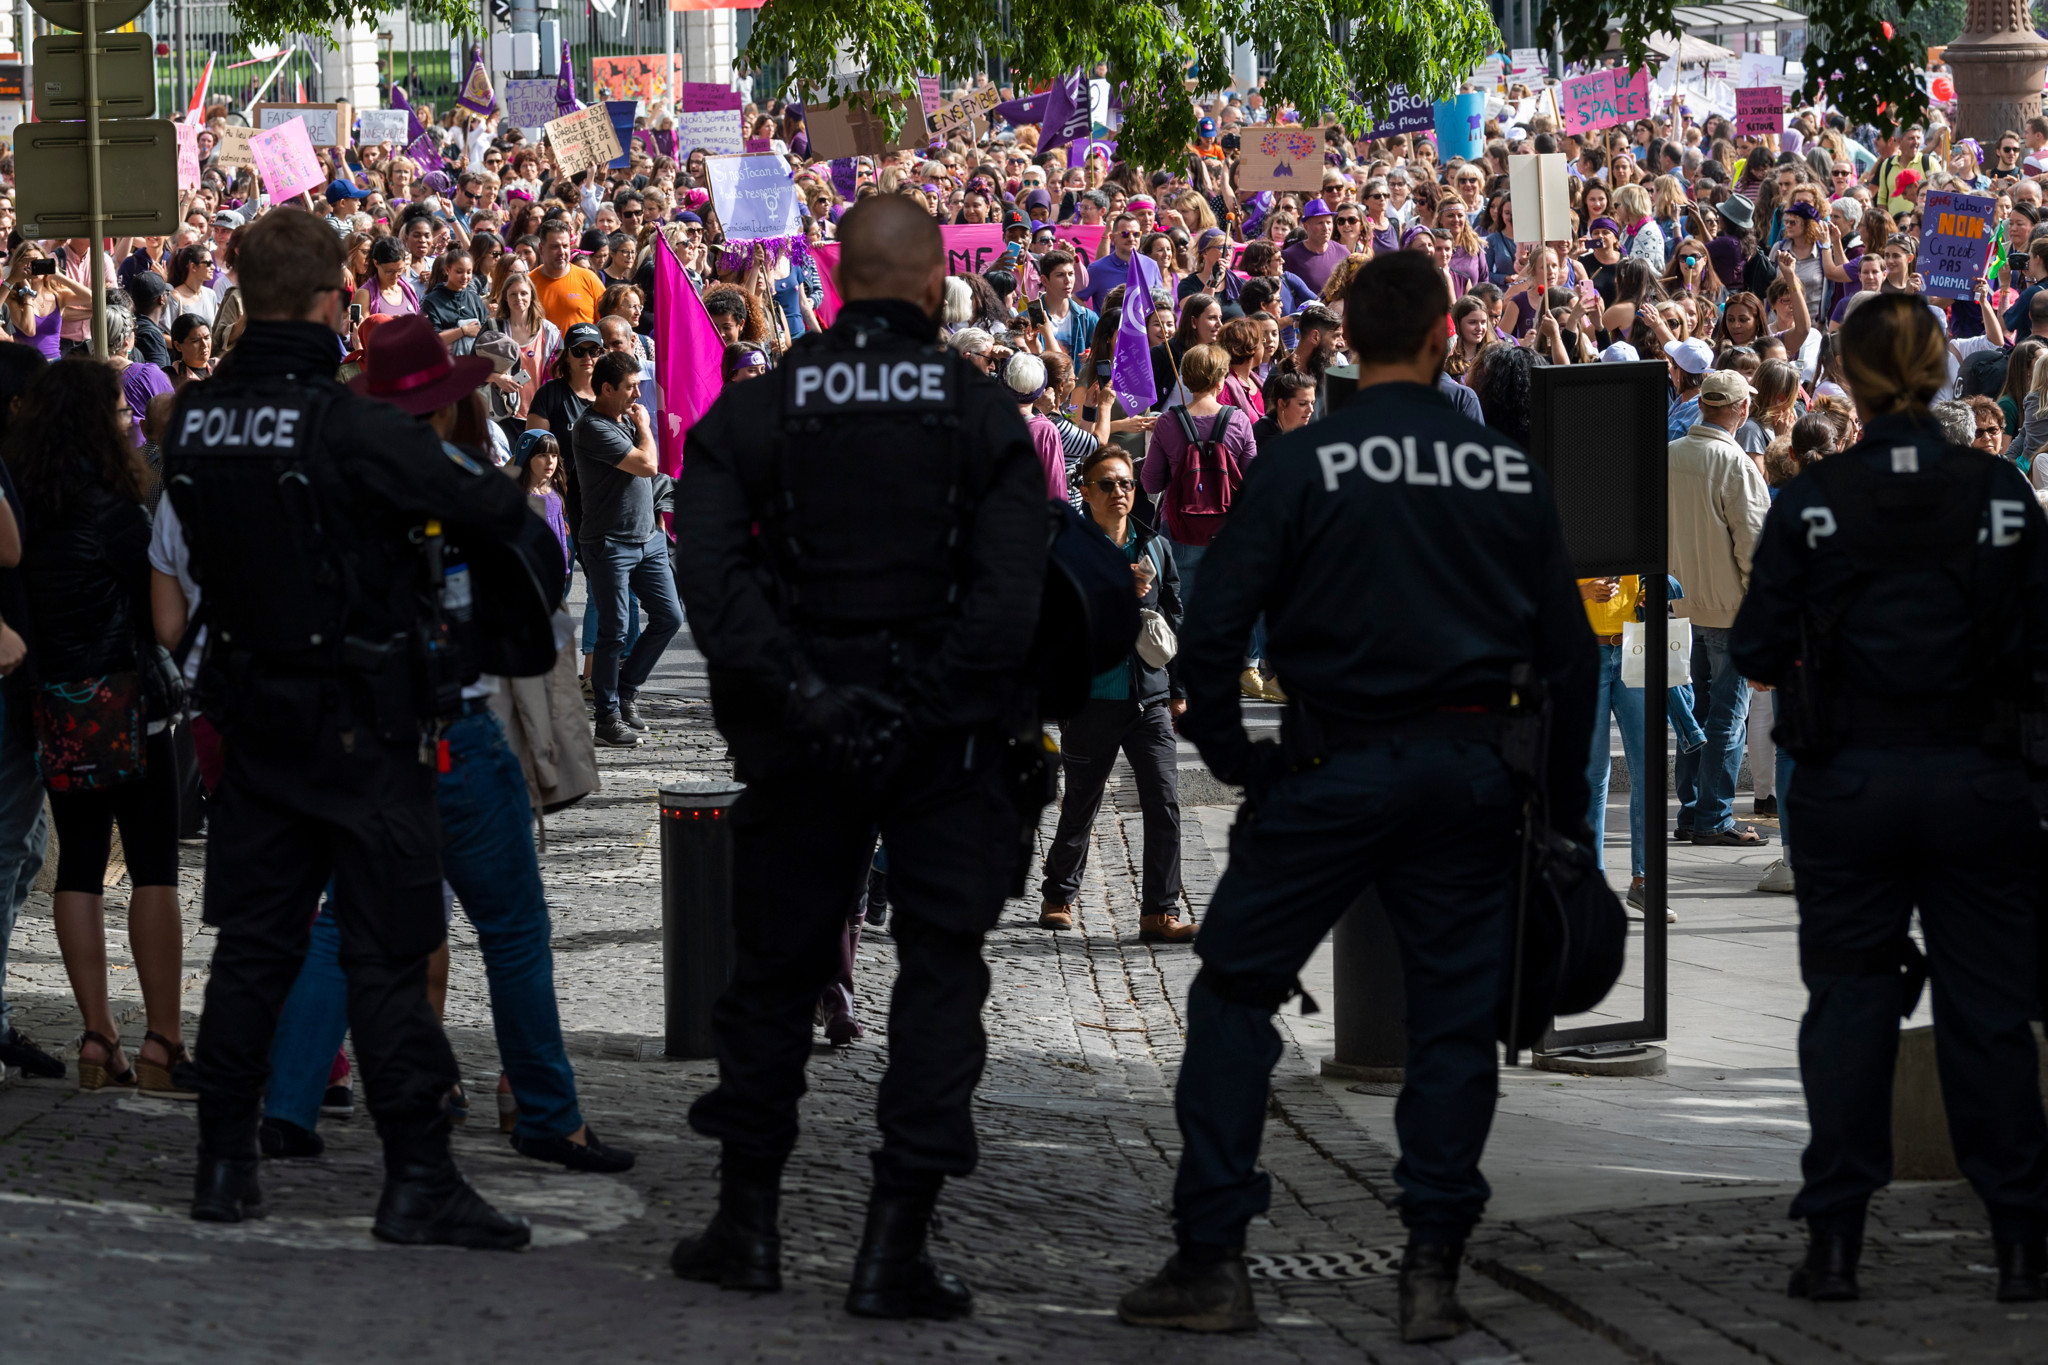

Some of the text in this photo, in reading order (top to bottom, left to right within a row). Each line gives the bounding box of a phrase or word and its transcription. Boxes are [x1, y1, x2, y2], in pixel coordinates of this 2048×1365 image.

[1570, 79, 1605, 99] TAKE
[552, 122, 561, 131] LA
[563, 111, 587, 125] FEMME
[589, 105, 604, 116] EST
[1379, 116, 1428, 131] des fleurs
[1954, 197, 1981, 213] tabou
[1938, 213, 1984, 239] NON
[1939, 259, 1961, 272] PAS
[1930, 275, 1970, 290] NORMAL
[796, 361, 945, 407] POLICE
[179, 406, 300, 448] POLICE
[1316, 436, 1532, 494] POLICE
